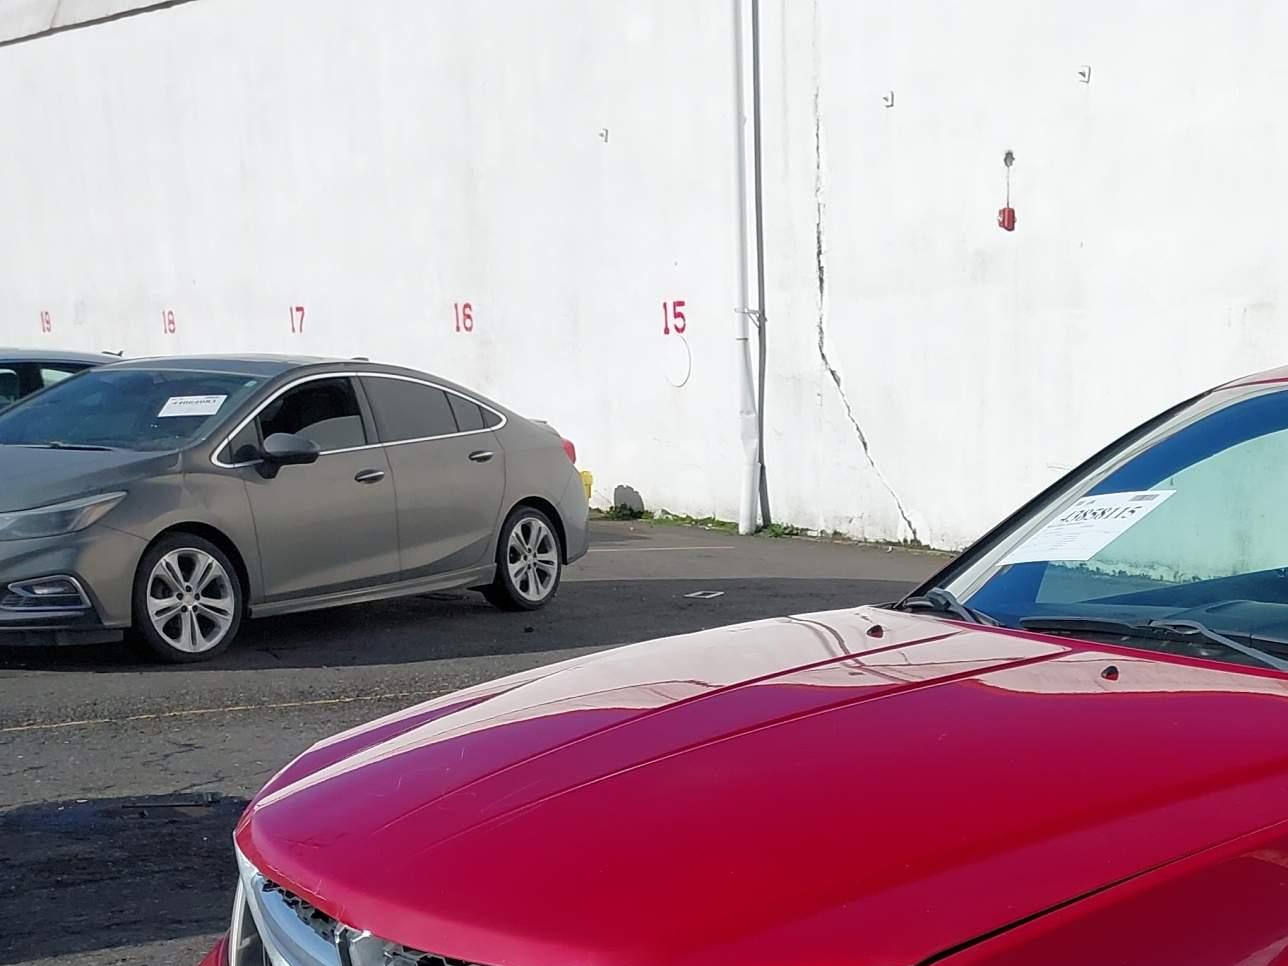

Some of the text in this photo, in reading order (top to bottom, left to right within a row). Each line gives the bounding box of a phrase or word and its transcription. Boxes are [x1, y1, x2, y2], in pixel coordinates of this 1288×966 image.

[40, 311, 52, 333] 19
[162, 310, 176, 334] 18
[290, 306, 305, 333] 17
[454, 302, 474, 332] 16
[662, 300, 687, 335] 15
